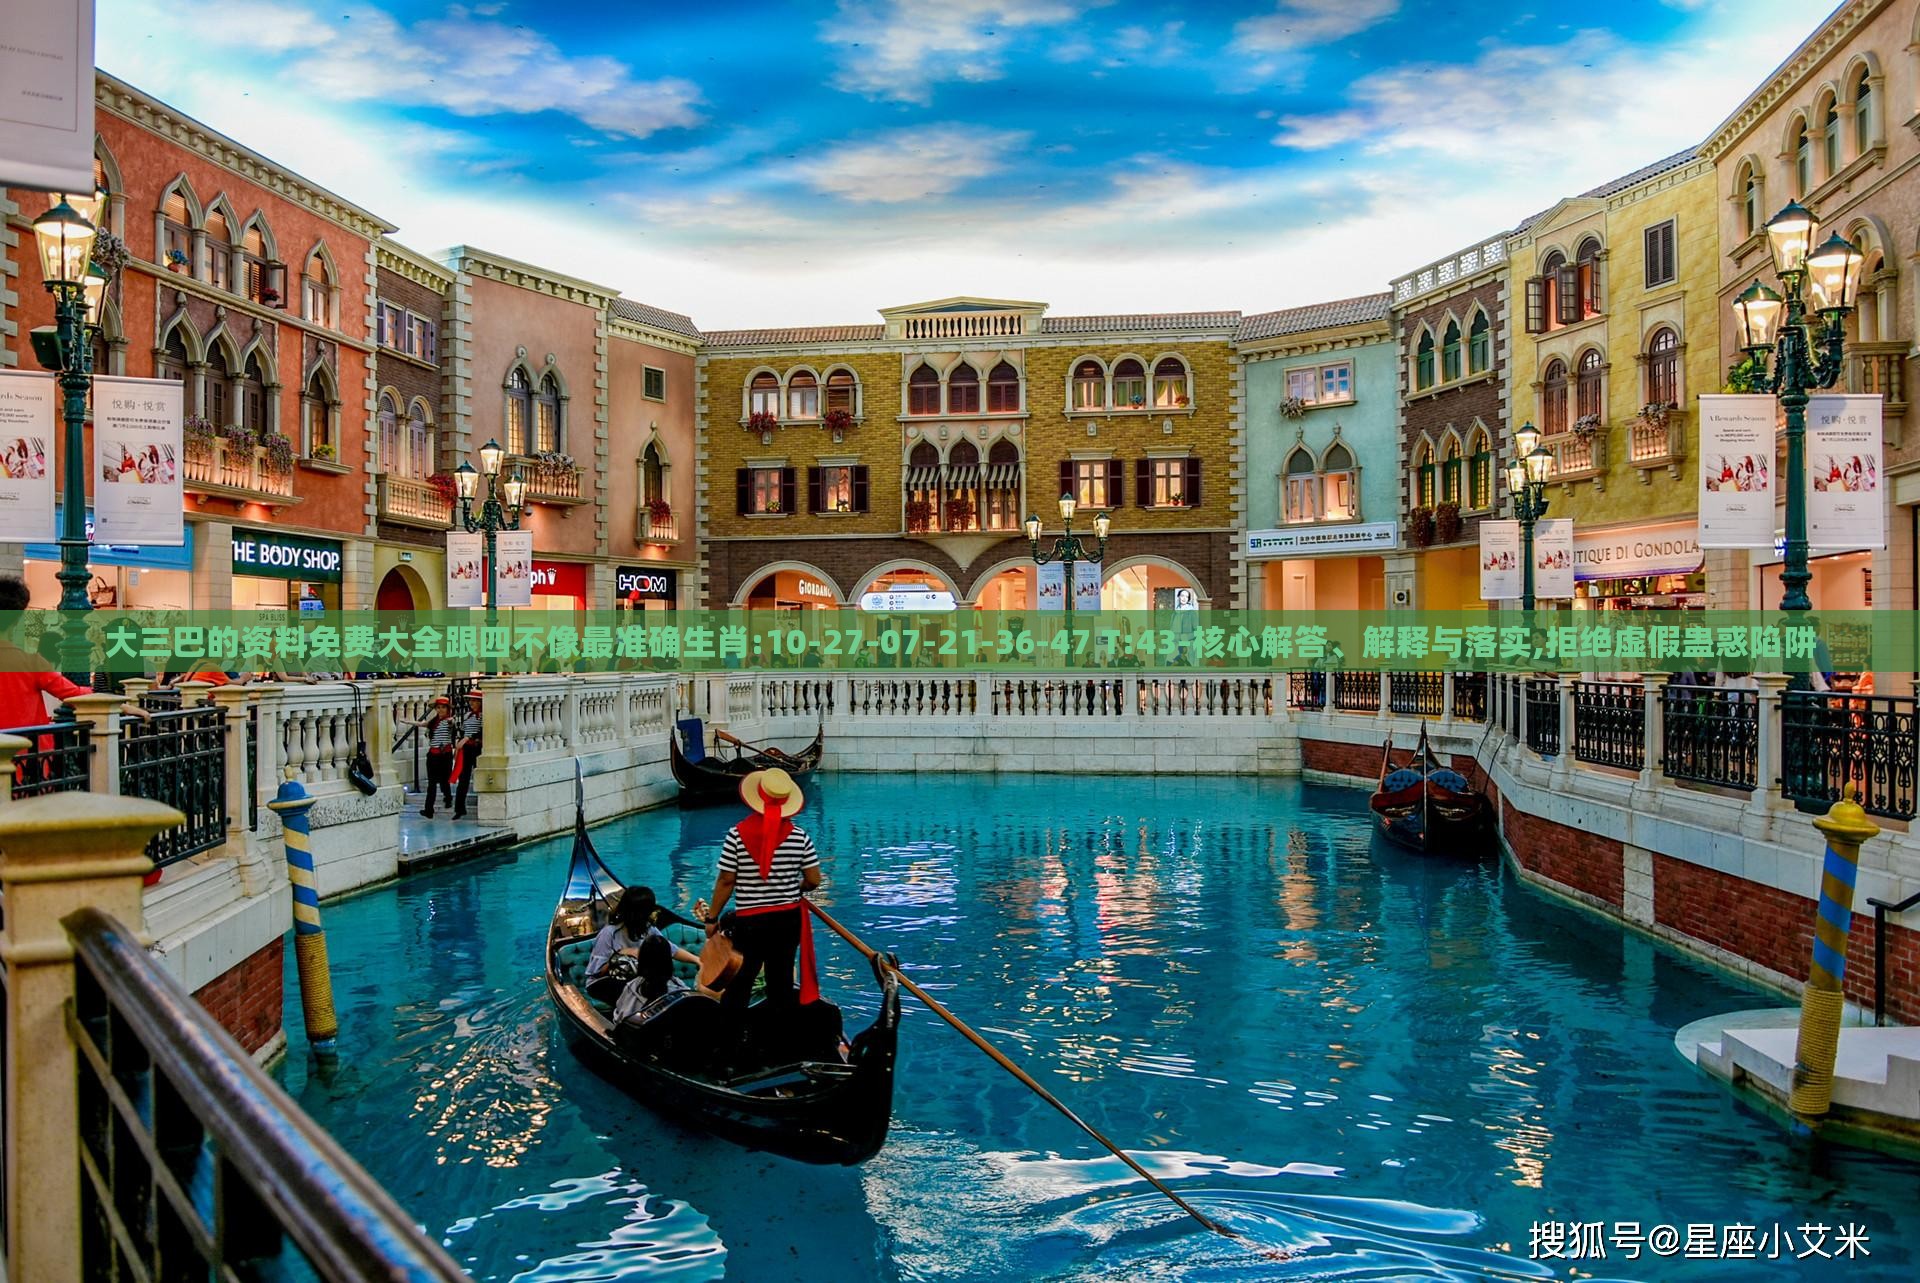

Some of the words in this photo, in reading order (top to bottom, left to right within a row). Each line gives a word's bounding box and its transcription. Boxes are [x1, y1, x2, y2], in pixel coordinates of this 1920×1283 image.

[260, 544, 301, 566] BODY
[1615, 545, 1629, 560] DI
[530, 568, 547, 588] ph
[618, 574, 668, 593] HOM
[258, 613, 269, 621] SPA
